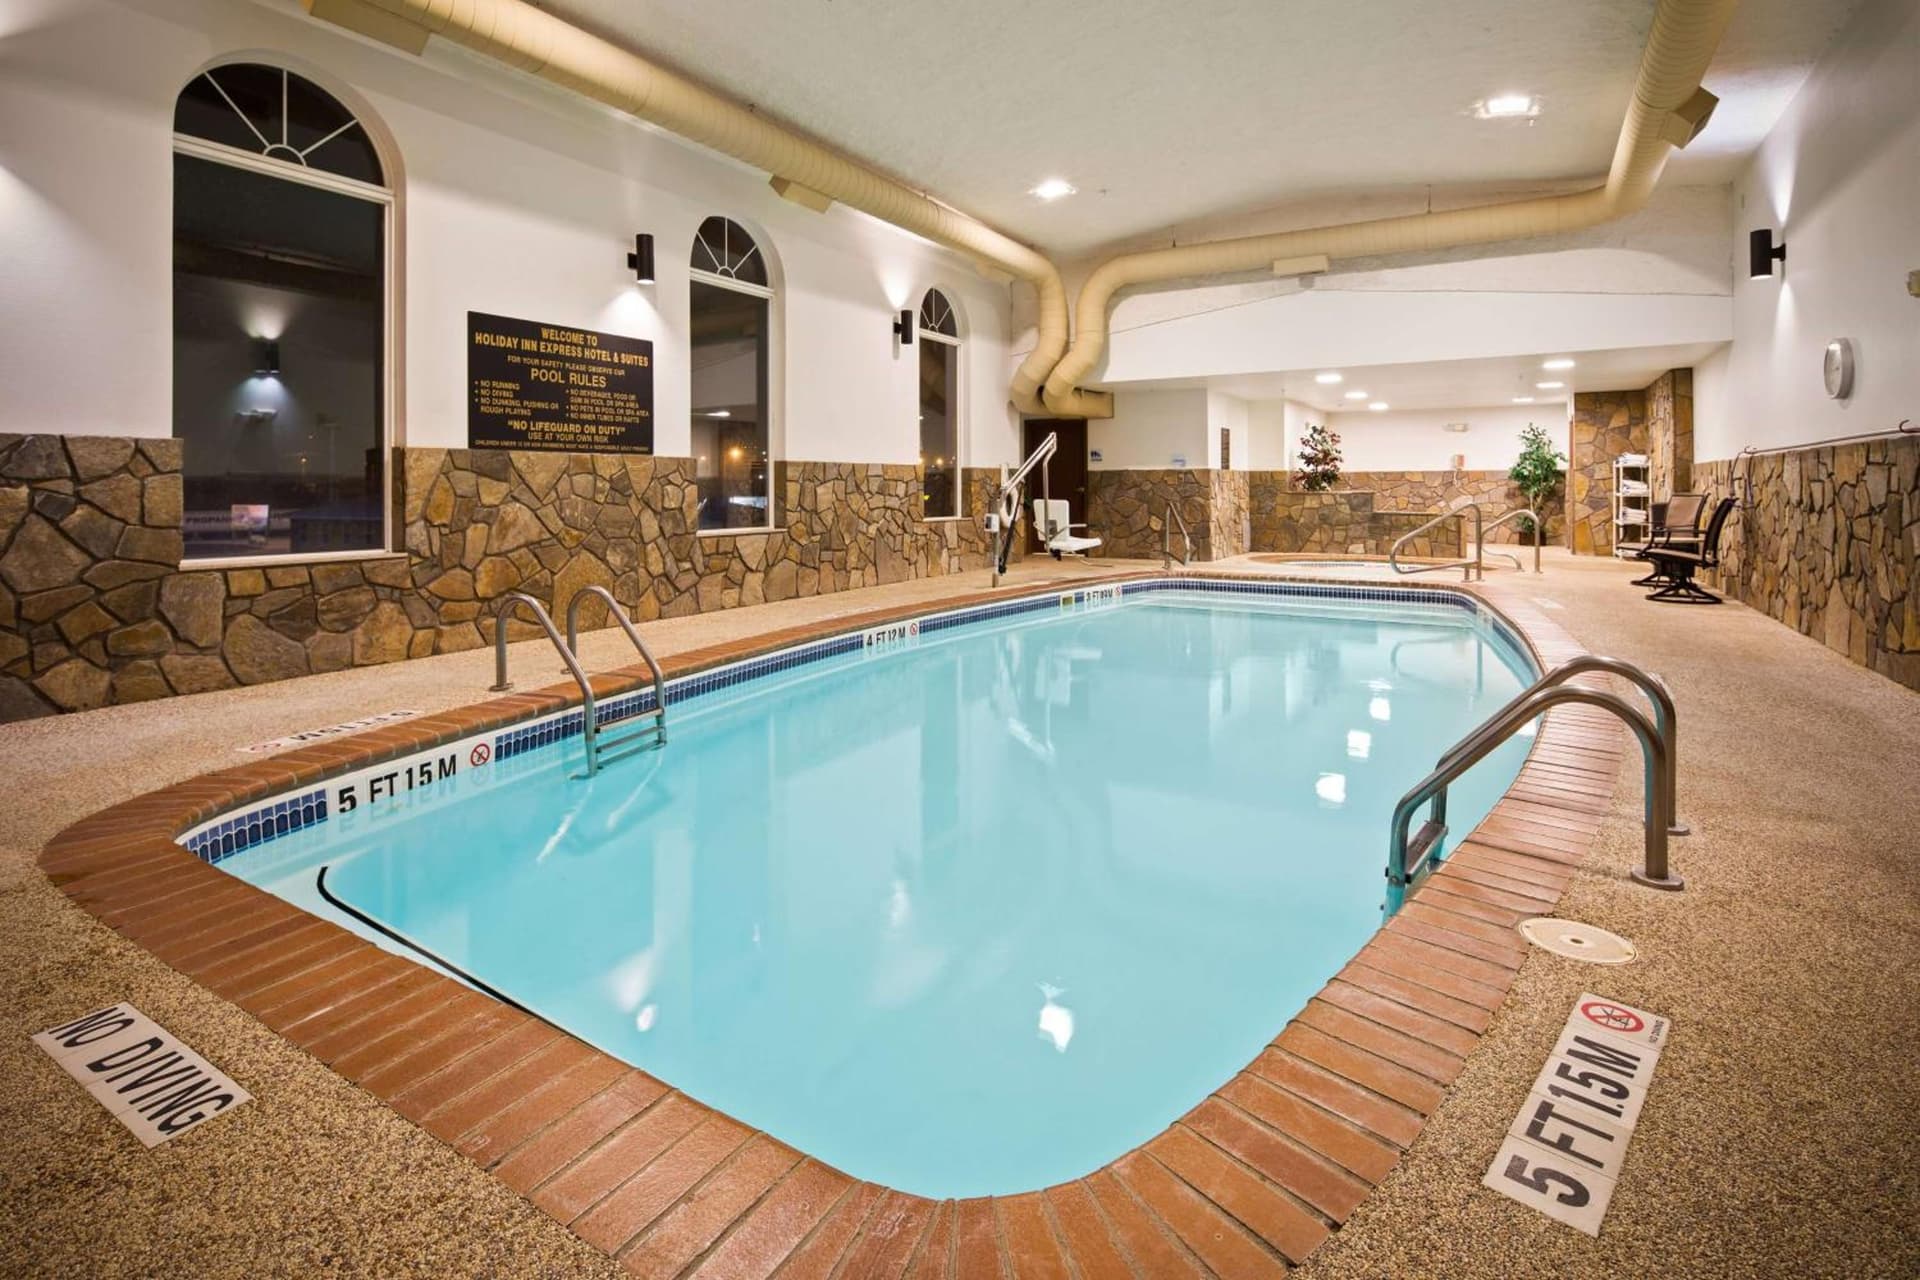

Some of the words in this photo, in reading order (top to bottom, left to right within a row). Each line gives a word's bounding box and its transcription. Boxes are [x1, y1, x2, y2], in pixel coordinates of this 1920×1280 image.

[475, 332, 519, 349] HOLIDAY
[521, 339, 537, 350] INN
[540, 341, 582, 358] EXPRESS
[584, 349, 611, 362] HOTEL
[621, 354, 648, 367] SUITES
[541, 328, 584, 344] WELCOME
[587, 335, 598, 346] TO
[523, 357, 539, 365] YOUR
[541, 360, 563, 368] SAFETY
[565, 363, 586, 371] PLEASE
[531, 368, 564, 383] POOL
[570, 374, 607, 388] RULES
[528, 431, 542, 441] USE
[556, 433, 575, 442] YOUR
[530, 422, 581, 433] LIFEGUARD
[584, 425, 596, 433] ON
[867, 634, 872, 646] 4
[877, 631, 886, 644] FT
[339, 786, 357, 813] 5
[370, 772, 398, 803] FT
[48, 1007, 135, 1047] NO
[86, 1037, 234, 1135] DIVING
[1526, 1101, 1614, 1169] FT
[1504, 1155, 1590, 1207] 5
